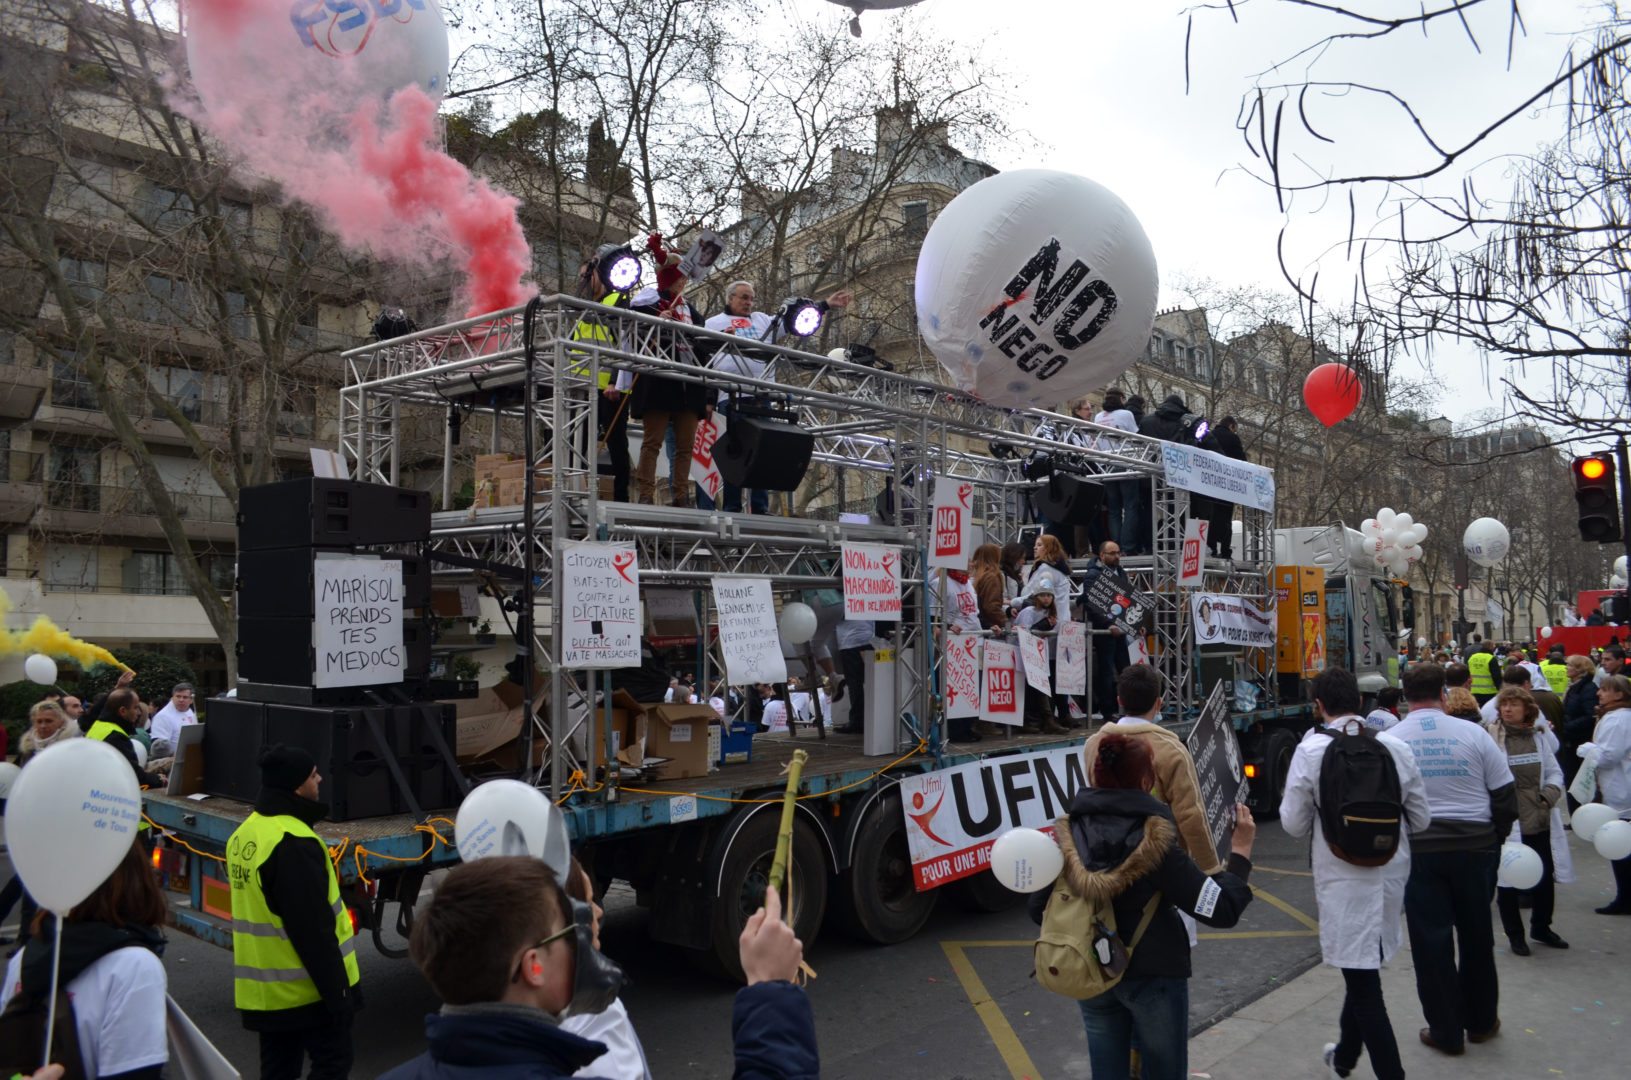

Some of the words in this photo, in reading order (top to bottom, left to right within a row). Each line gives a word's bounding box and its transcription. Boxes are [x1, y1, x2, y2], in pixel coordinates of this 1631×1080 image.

[1003, 237, 1117, 351] NO
[979, 301, 1069, 380] NEGO
[1193, 453, 1222, 474] FEDERATION
[1222, 463, 1232, 477] DES
[1200, 471, 1226, 490] DENTAIRES
[938, 509, 957, 531] NO
[937, 533, 958, 549] NEGO
[845, 549, 866, 571] NON
[1185, 543, 1196, 559] NO
[1102, 568, 1113, 578] LOI
[1184, 561, 1196, 573] NEGO
[321, 575, 400, 604] MARISOL
[1094, 580, 1104, 590] FIN
[1103, 587, 1114, 596] DU
[1099, 574, 1126, 595] TOURAINE
[577, 592, 615, 603] CONTRE
[619, 594, 630, 604] LA
[1089, 587, 1113, 604] SECRET
[330, 606, 393, 625] PRENDS
[719, 620, 729, 629] LA
[1359, 587, 1371, 665] IMPACT
[340, 627, 377, 645] TES
[721, 631, 748, 643] VEND
[326, 645, 401, 673] MEDOCS
[566, 651, 578, 662] VA
[581, 650, 591, 661] TE
[989, 670, 1011, 690] NO
[991, 691, 1012, 705] NEGO
[1196, 734, 1217, 778] TOURAINE
[1201, 780, 1211, 800] FIN
[1208, 767, 1217, 788] DU
[82, 801, 109, 814] Pour
[1207, 784, 1224, 824] SECRET
[94, 820, 107, 829] de
[921, 859, 952, 884] POUR
[954, 850, 976, 873] UNE
